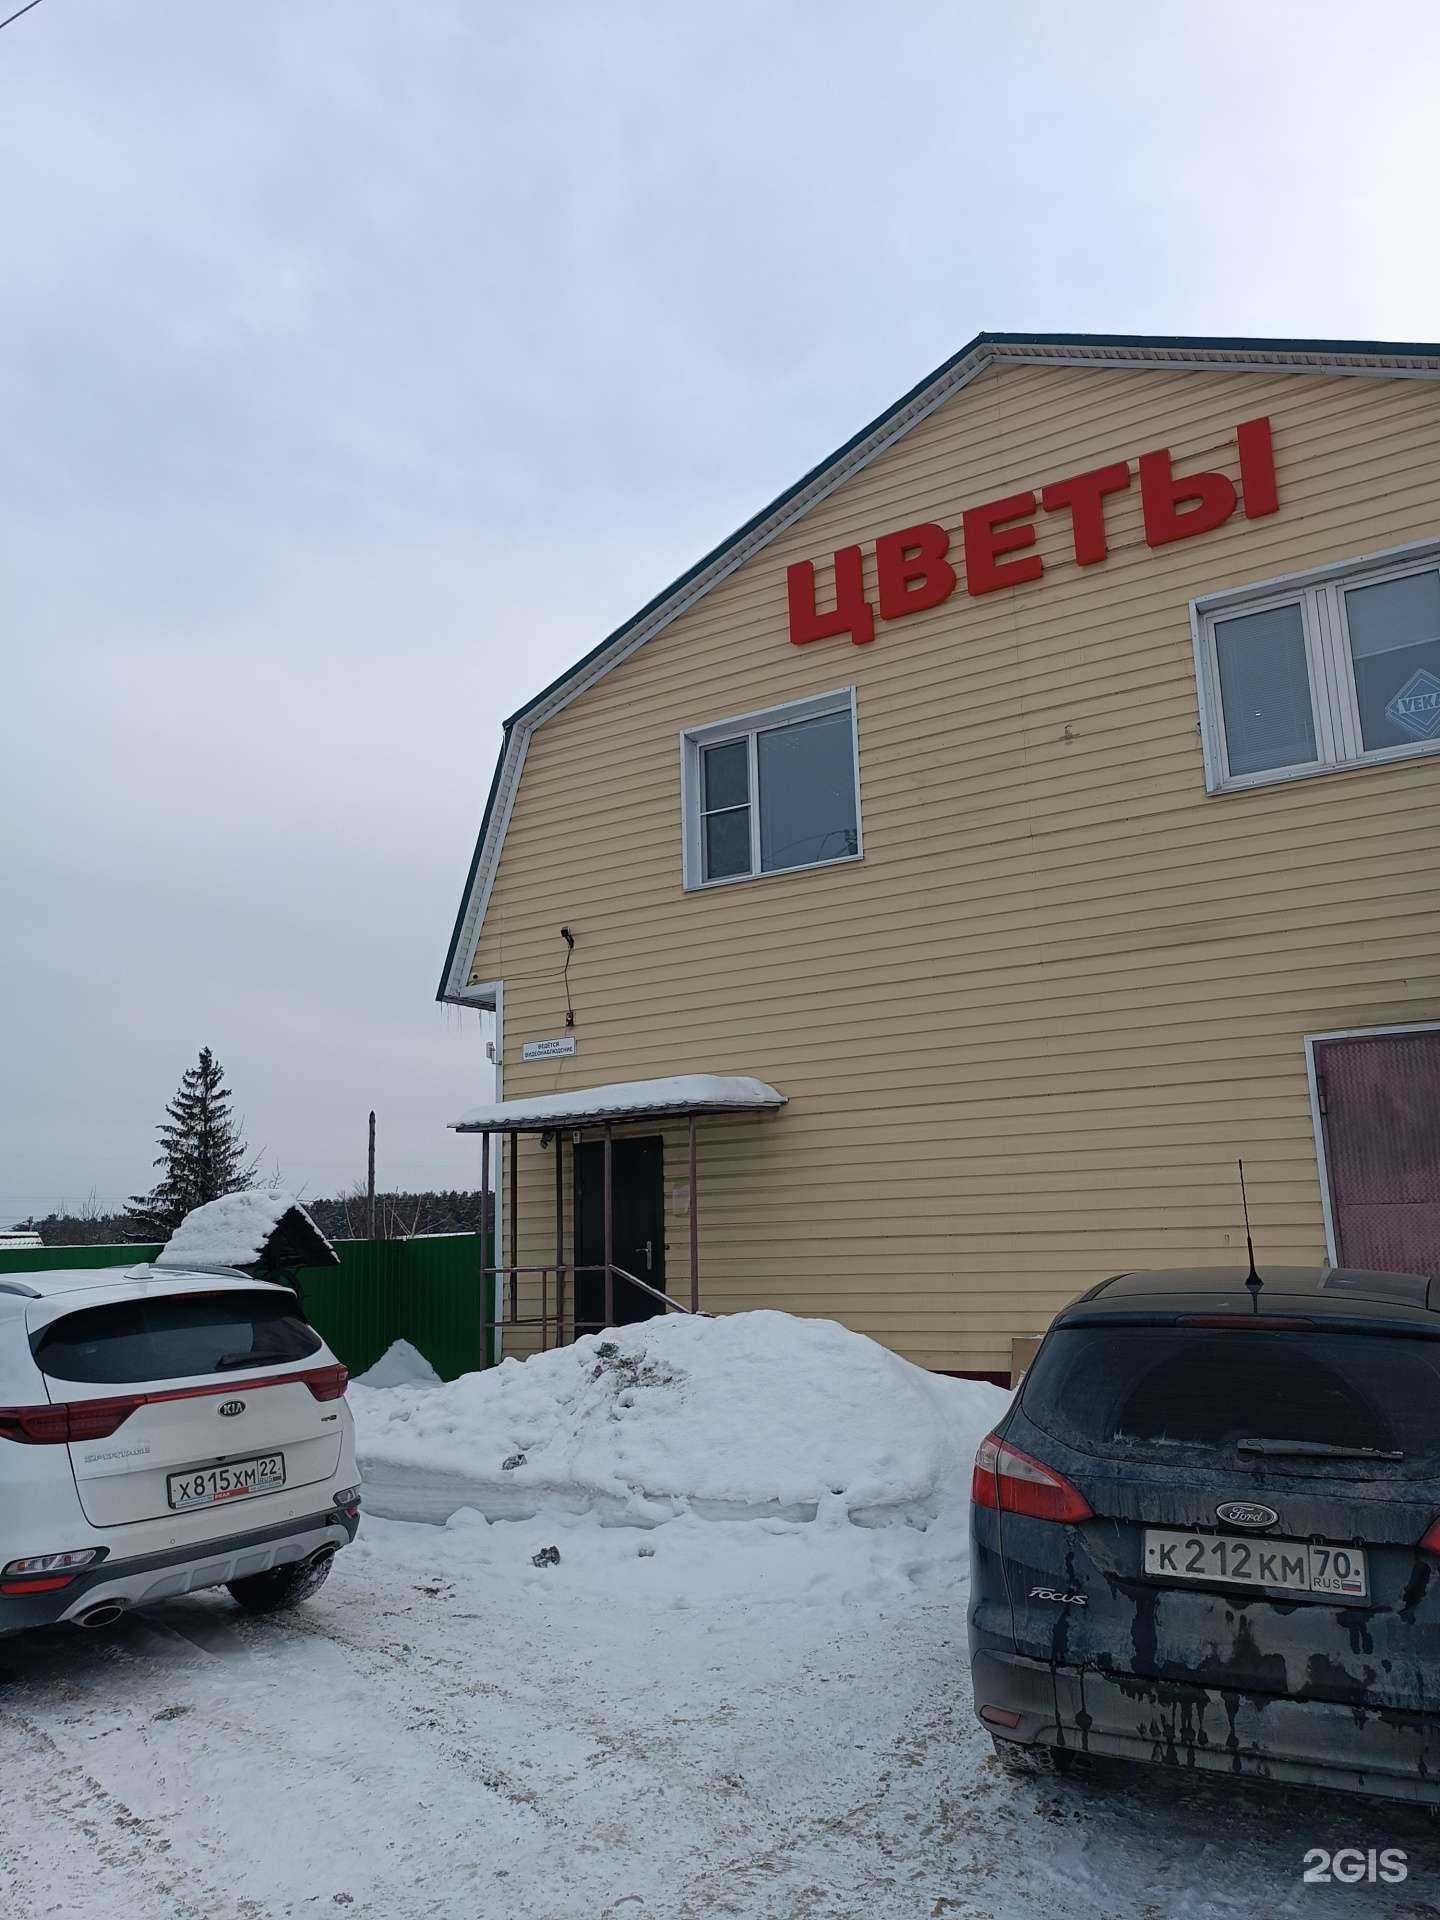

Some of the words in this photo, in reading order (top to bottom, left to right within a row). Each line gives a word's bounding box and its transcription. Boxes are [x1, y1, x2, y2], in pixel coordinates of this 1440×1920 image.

[787, 416, 1279, 646] ЦВЕТЫ
[223, 1402, 243, 1414] KIA
[260, 1459, 277, 1476] 22
[1229, 1506, 1264, 1522] Ford
[1159, 1539, 1304, 1584] К212КМ
[1313, 1550, 1351, 1579] 70
[1313, 1577, 1341, 1590] RUS
